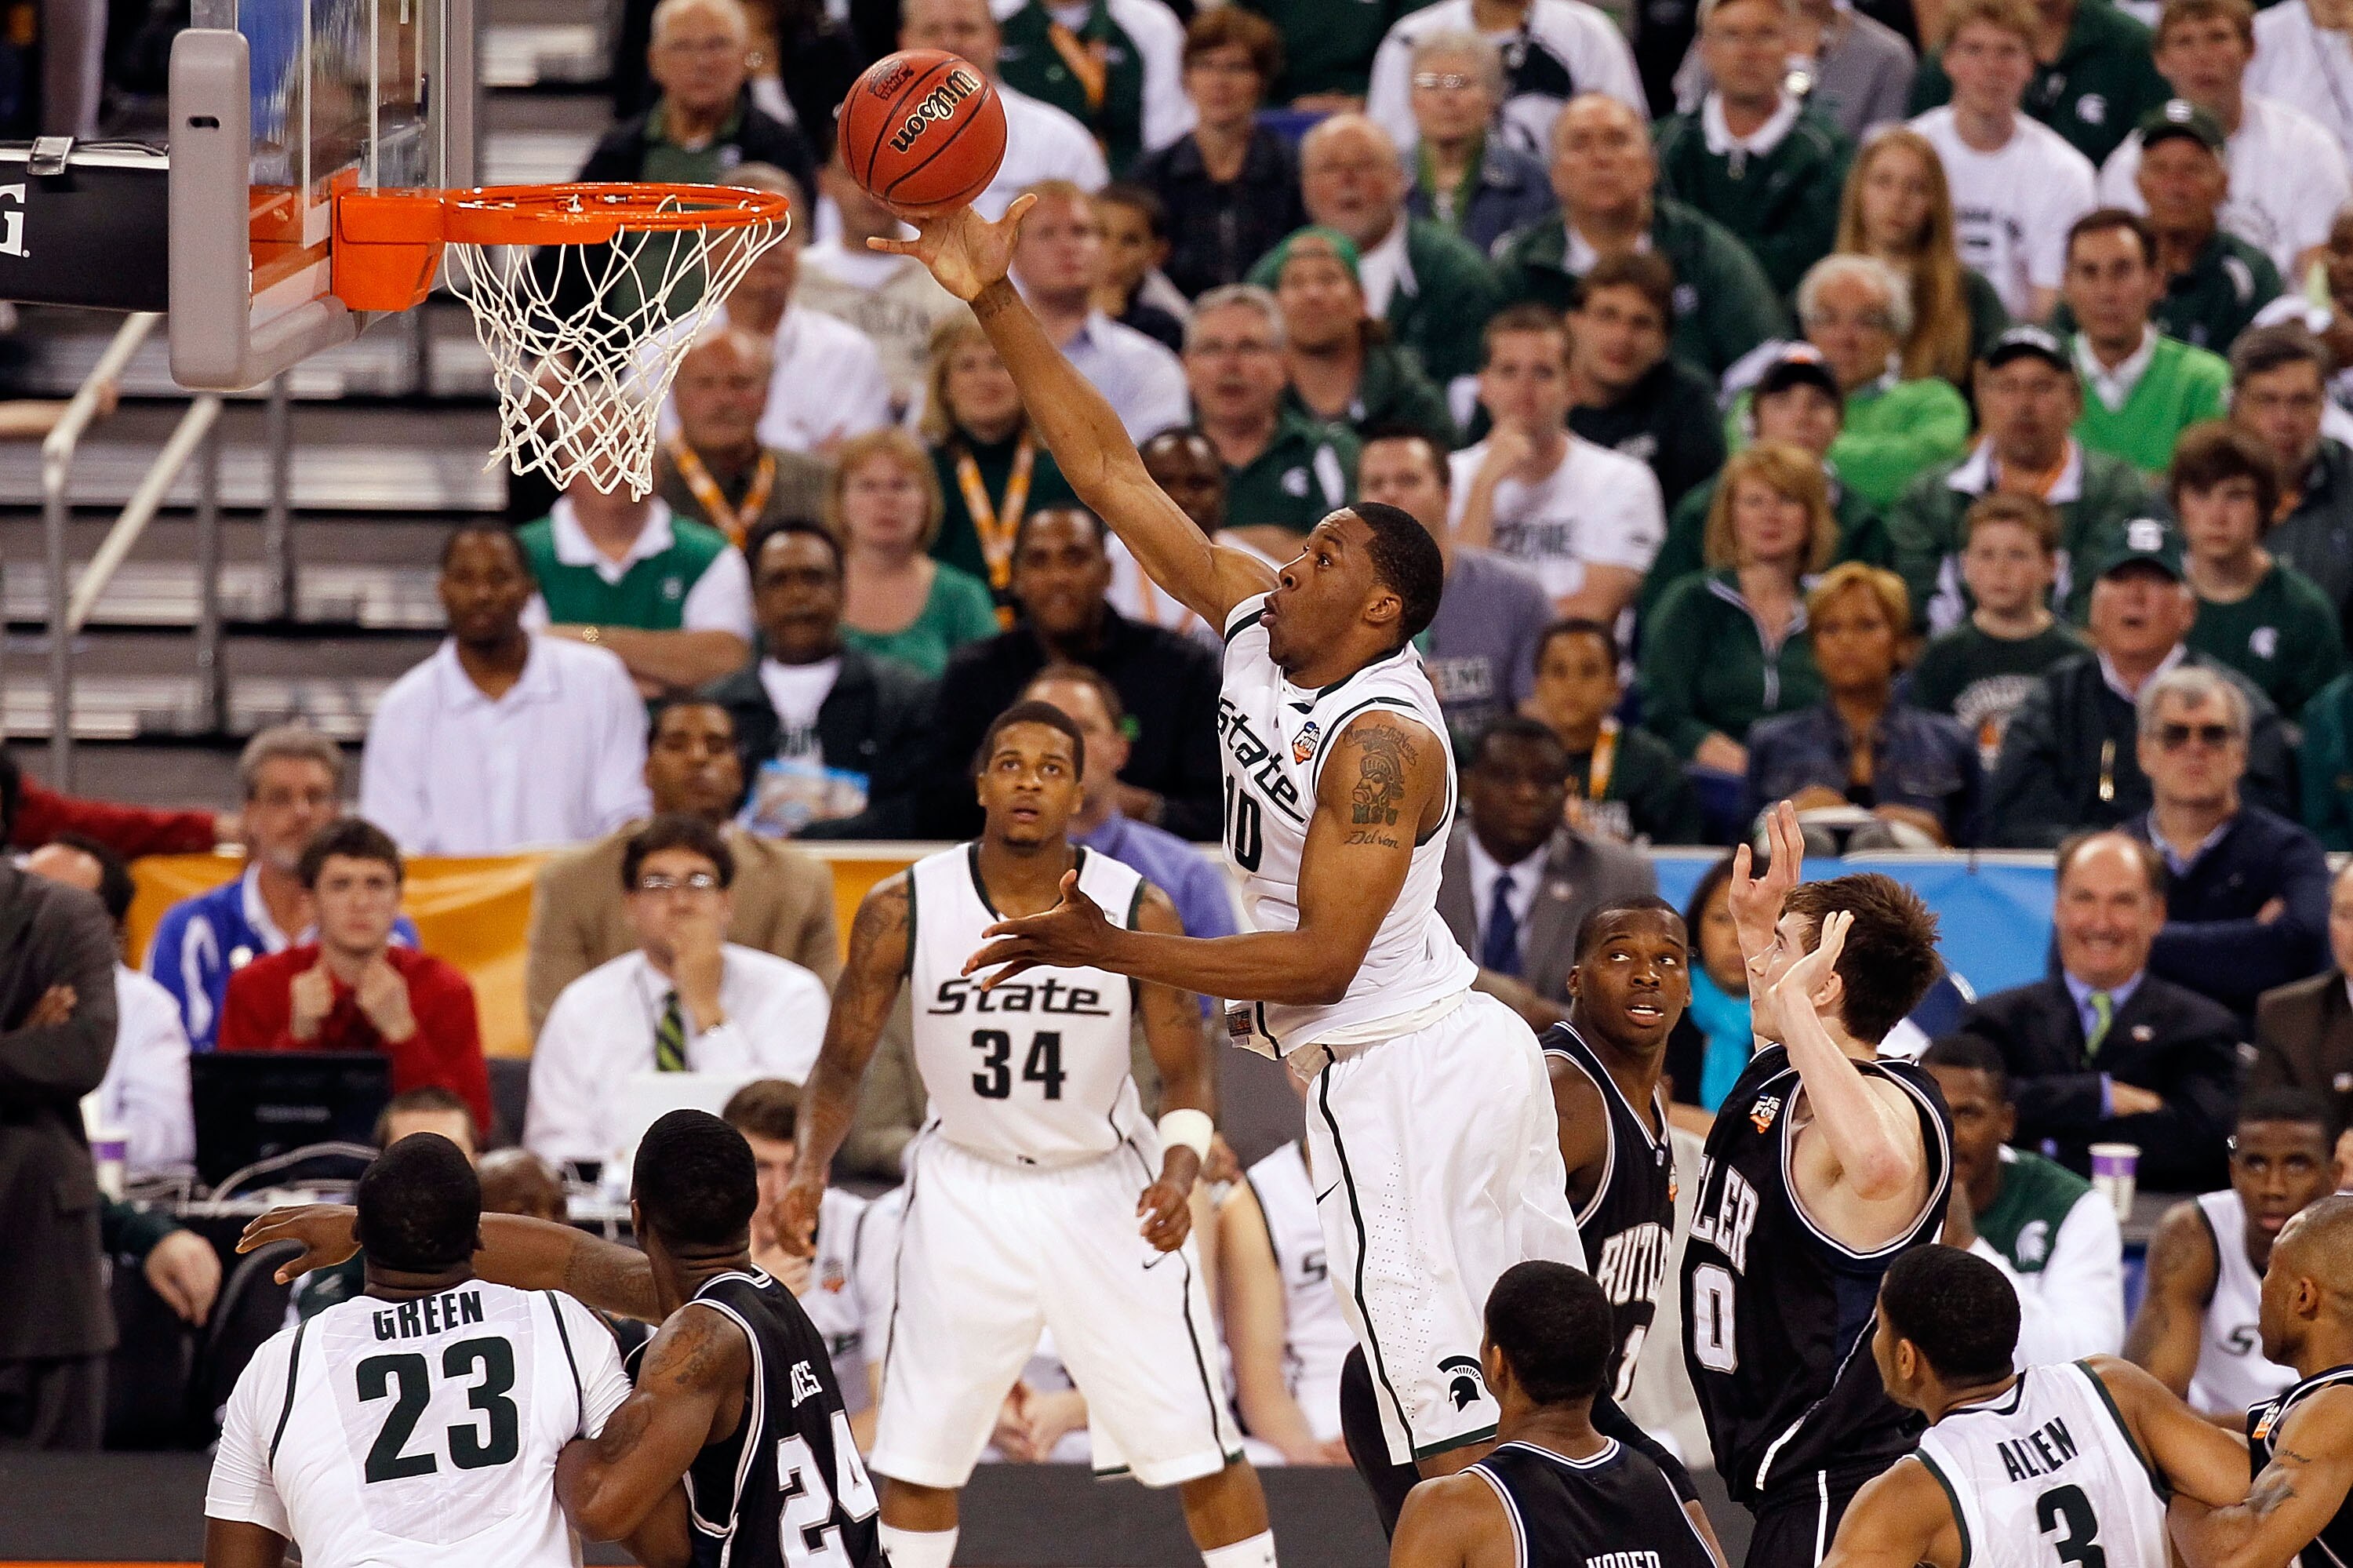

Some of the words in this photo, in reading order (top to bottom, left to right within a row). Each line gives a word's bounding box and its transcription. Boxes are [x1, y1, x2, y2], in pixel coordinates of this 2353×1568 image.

[888, 69, 981, 154] Wilson
[1217, 697, 1306, 824] State
[1226, 772, 1262, 873] 10
[927, 977, 1110, 1017] State
[972, 1028, 1066, 1101] 34
[373, 1291, 483, 1342] GREEN
[1693, 1262, 1738, 1375] 0
[356, 1336, 518, 1484] 23
[776, 1409, 879, 1568] 24
[2035, 1484, 2108, 1568] 3
